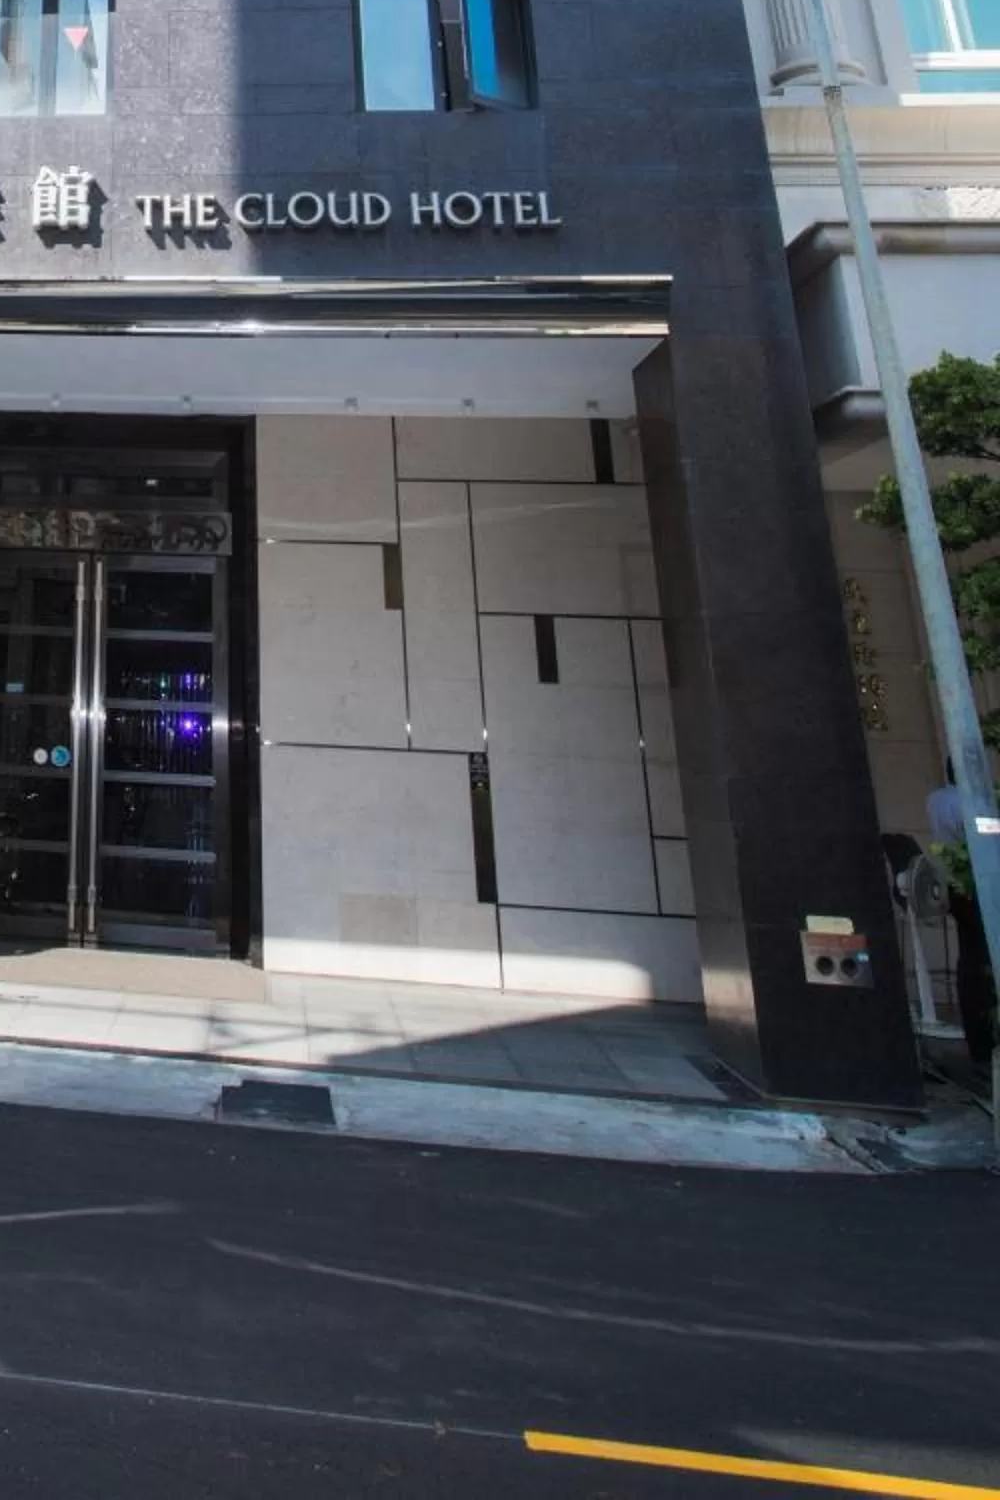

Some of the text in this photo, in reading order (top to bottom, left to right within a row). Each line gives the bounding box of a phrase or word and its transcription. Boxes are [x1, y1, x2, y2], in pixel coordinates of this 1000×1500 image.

[136, 192, 562, 228] THE CLOUD HOTEL
